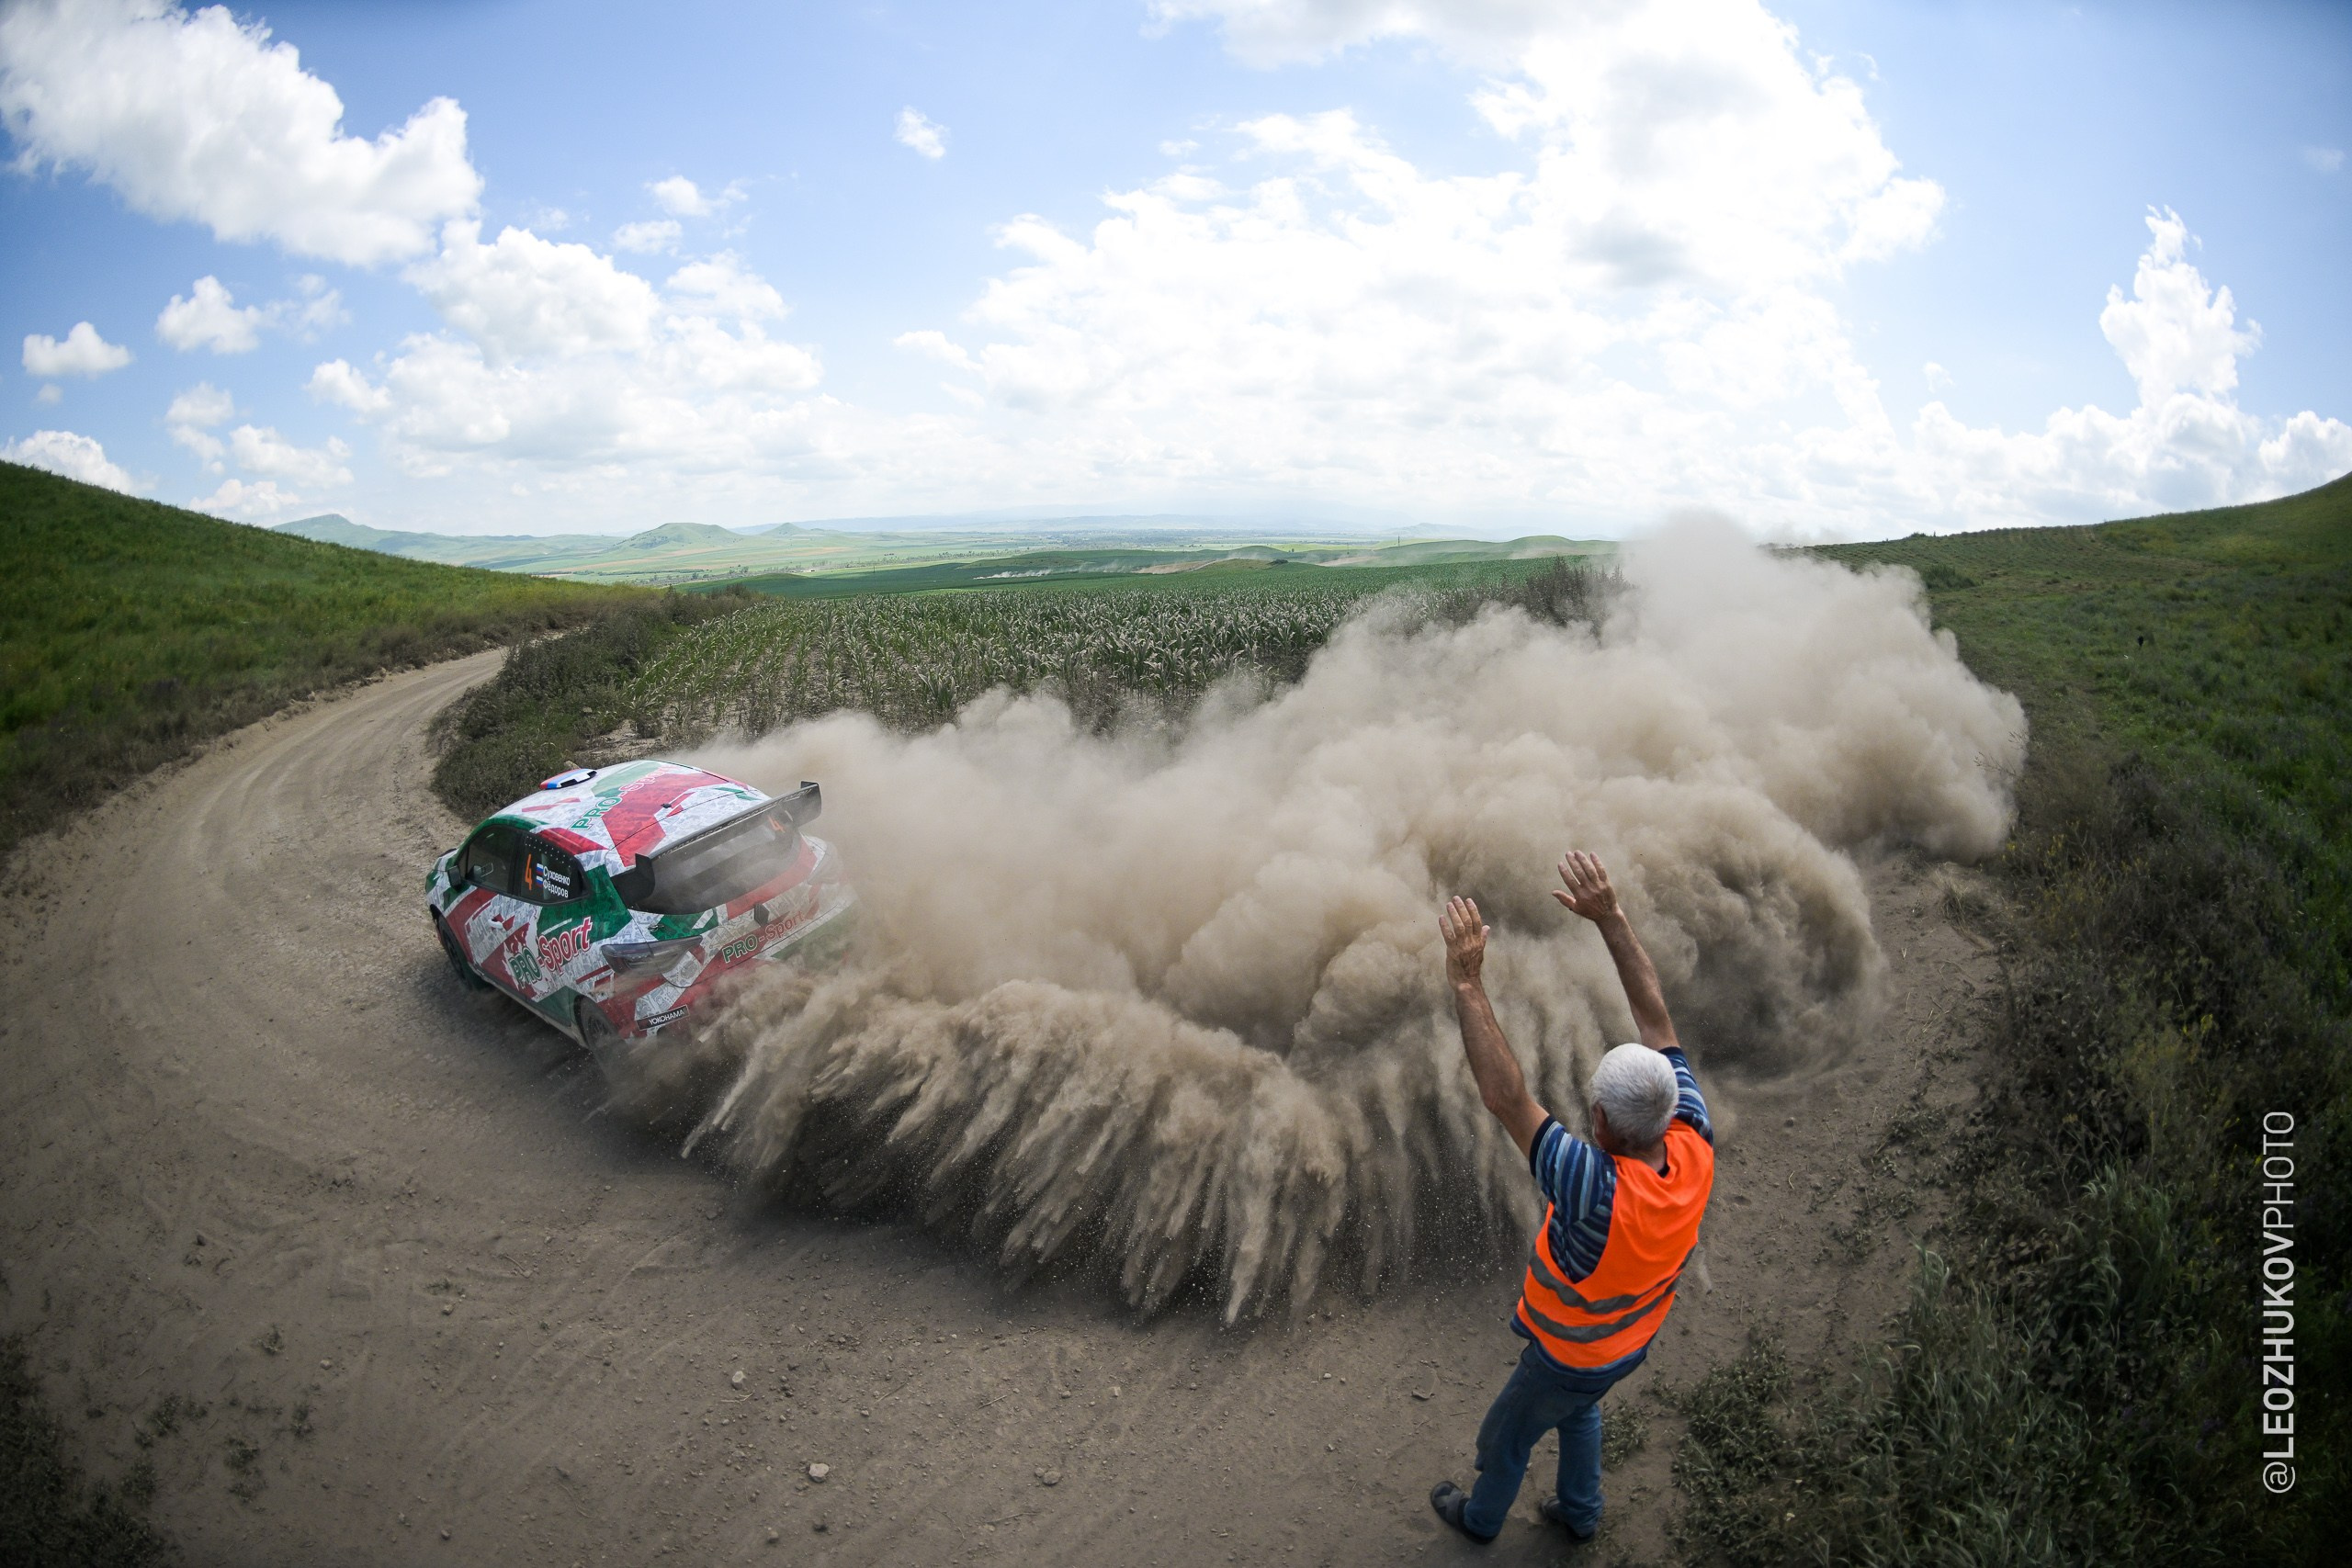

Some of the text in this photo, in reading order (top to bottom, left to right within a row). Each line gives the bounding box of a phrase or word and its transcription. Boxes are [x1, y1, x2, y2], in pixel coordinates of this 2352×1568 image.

[767, 815, 786, 833] 4
[525, 853, 532, 890] 4
[543, 865, 571, 886] Суховенко
[543, 879, 569, 898] Фёдоров
[722, 910, 805, 964] PRO-Sport
[508, 916, 593, 988] PRO-Sport
[648, 1009, 685, 1025] YOKOHAMA
